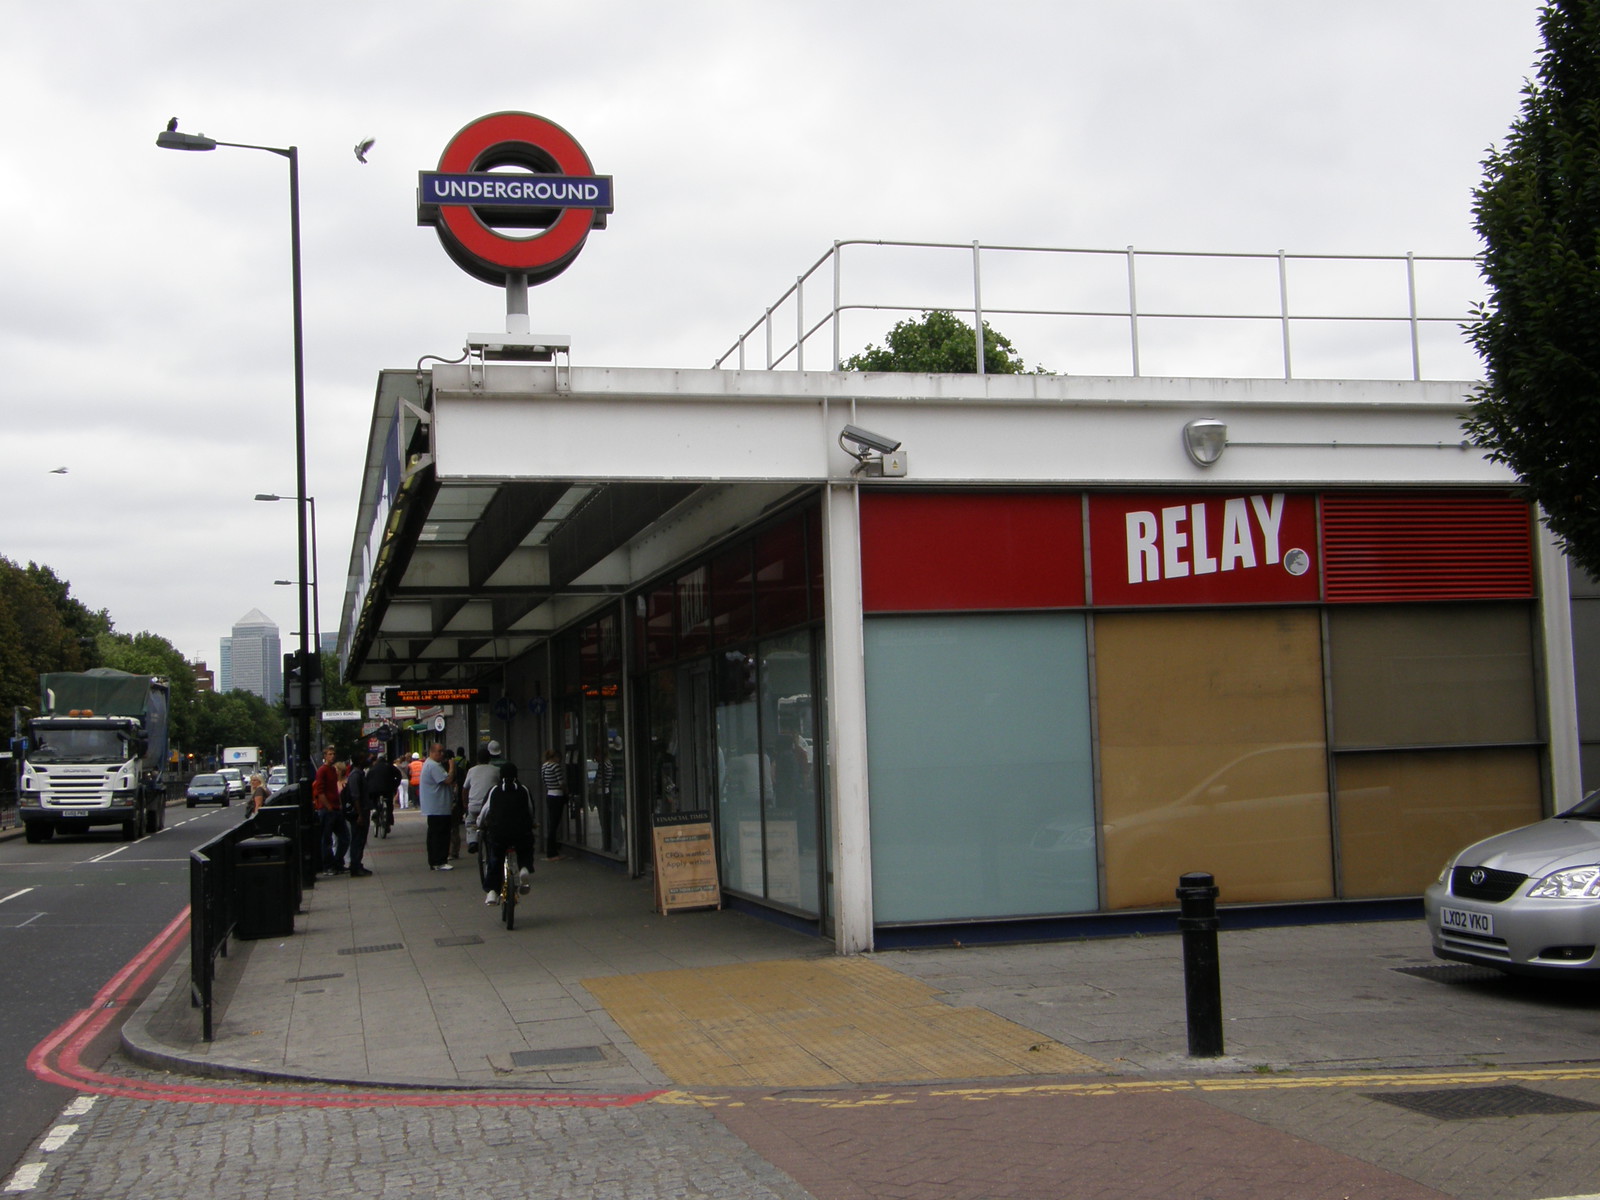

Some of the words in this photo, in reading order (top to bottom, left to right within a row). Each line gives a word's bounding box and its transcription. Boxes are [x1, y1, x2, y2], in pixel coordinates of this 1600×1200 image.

[434, 180, 599, 200] UNDERGROUND
[1125, 493, 1286, 585] RELAY
[656, 815, 689, 823] FINANCIAL
[689, 812, 709, 821] TIMES
[666, 859, 688, 871] Apply
[688, 857, 711, 866] within
[1443, 909, 1467, 928] LX02
[1468, 913, 1489, 931] VKO
